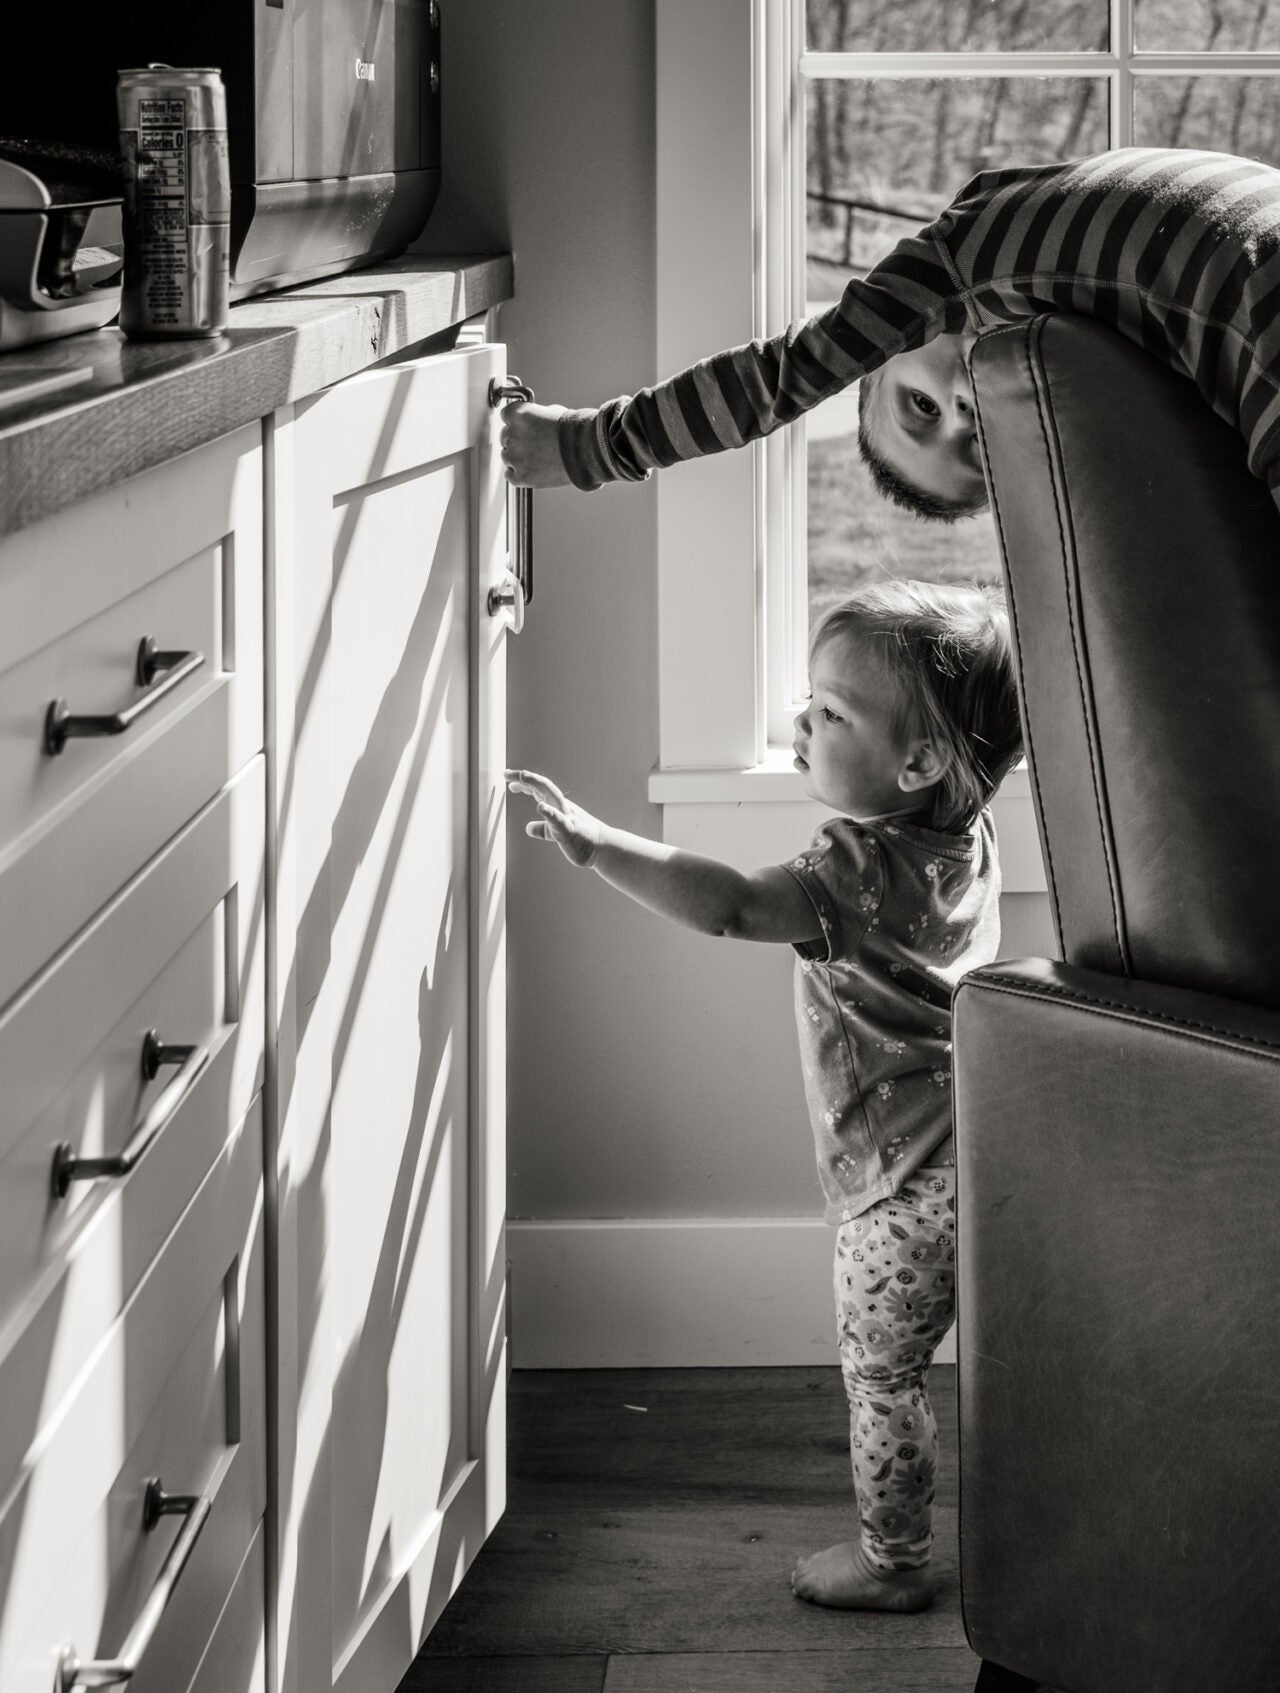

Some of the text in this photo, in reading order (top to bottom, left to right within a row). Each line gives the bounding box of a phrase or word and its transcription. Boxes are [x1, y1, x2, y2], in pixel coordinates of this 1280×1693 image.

[141, 101, 184, 113] Nutrition Facts
[142, 137, 175, 148] Calories
[176, 132, 184, 147] 0
